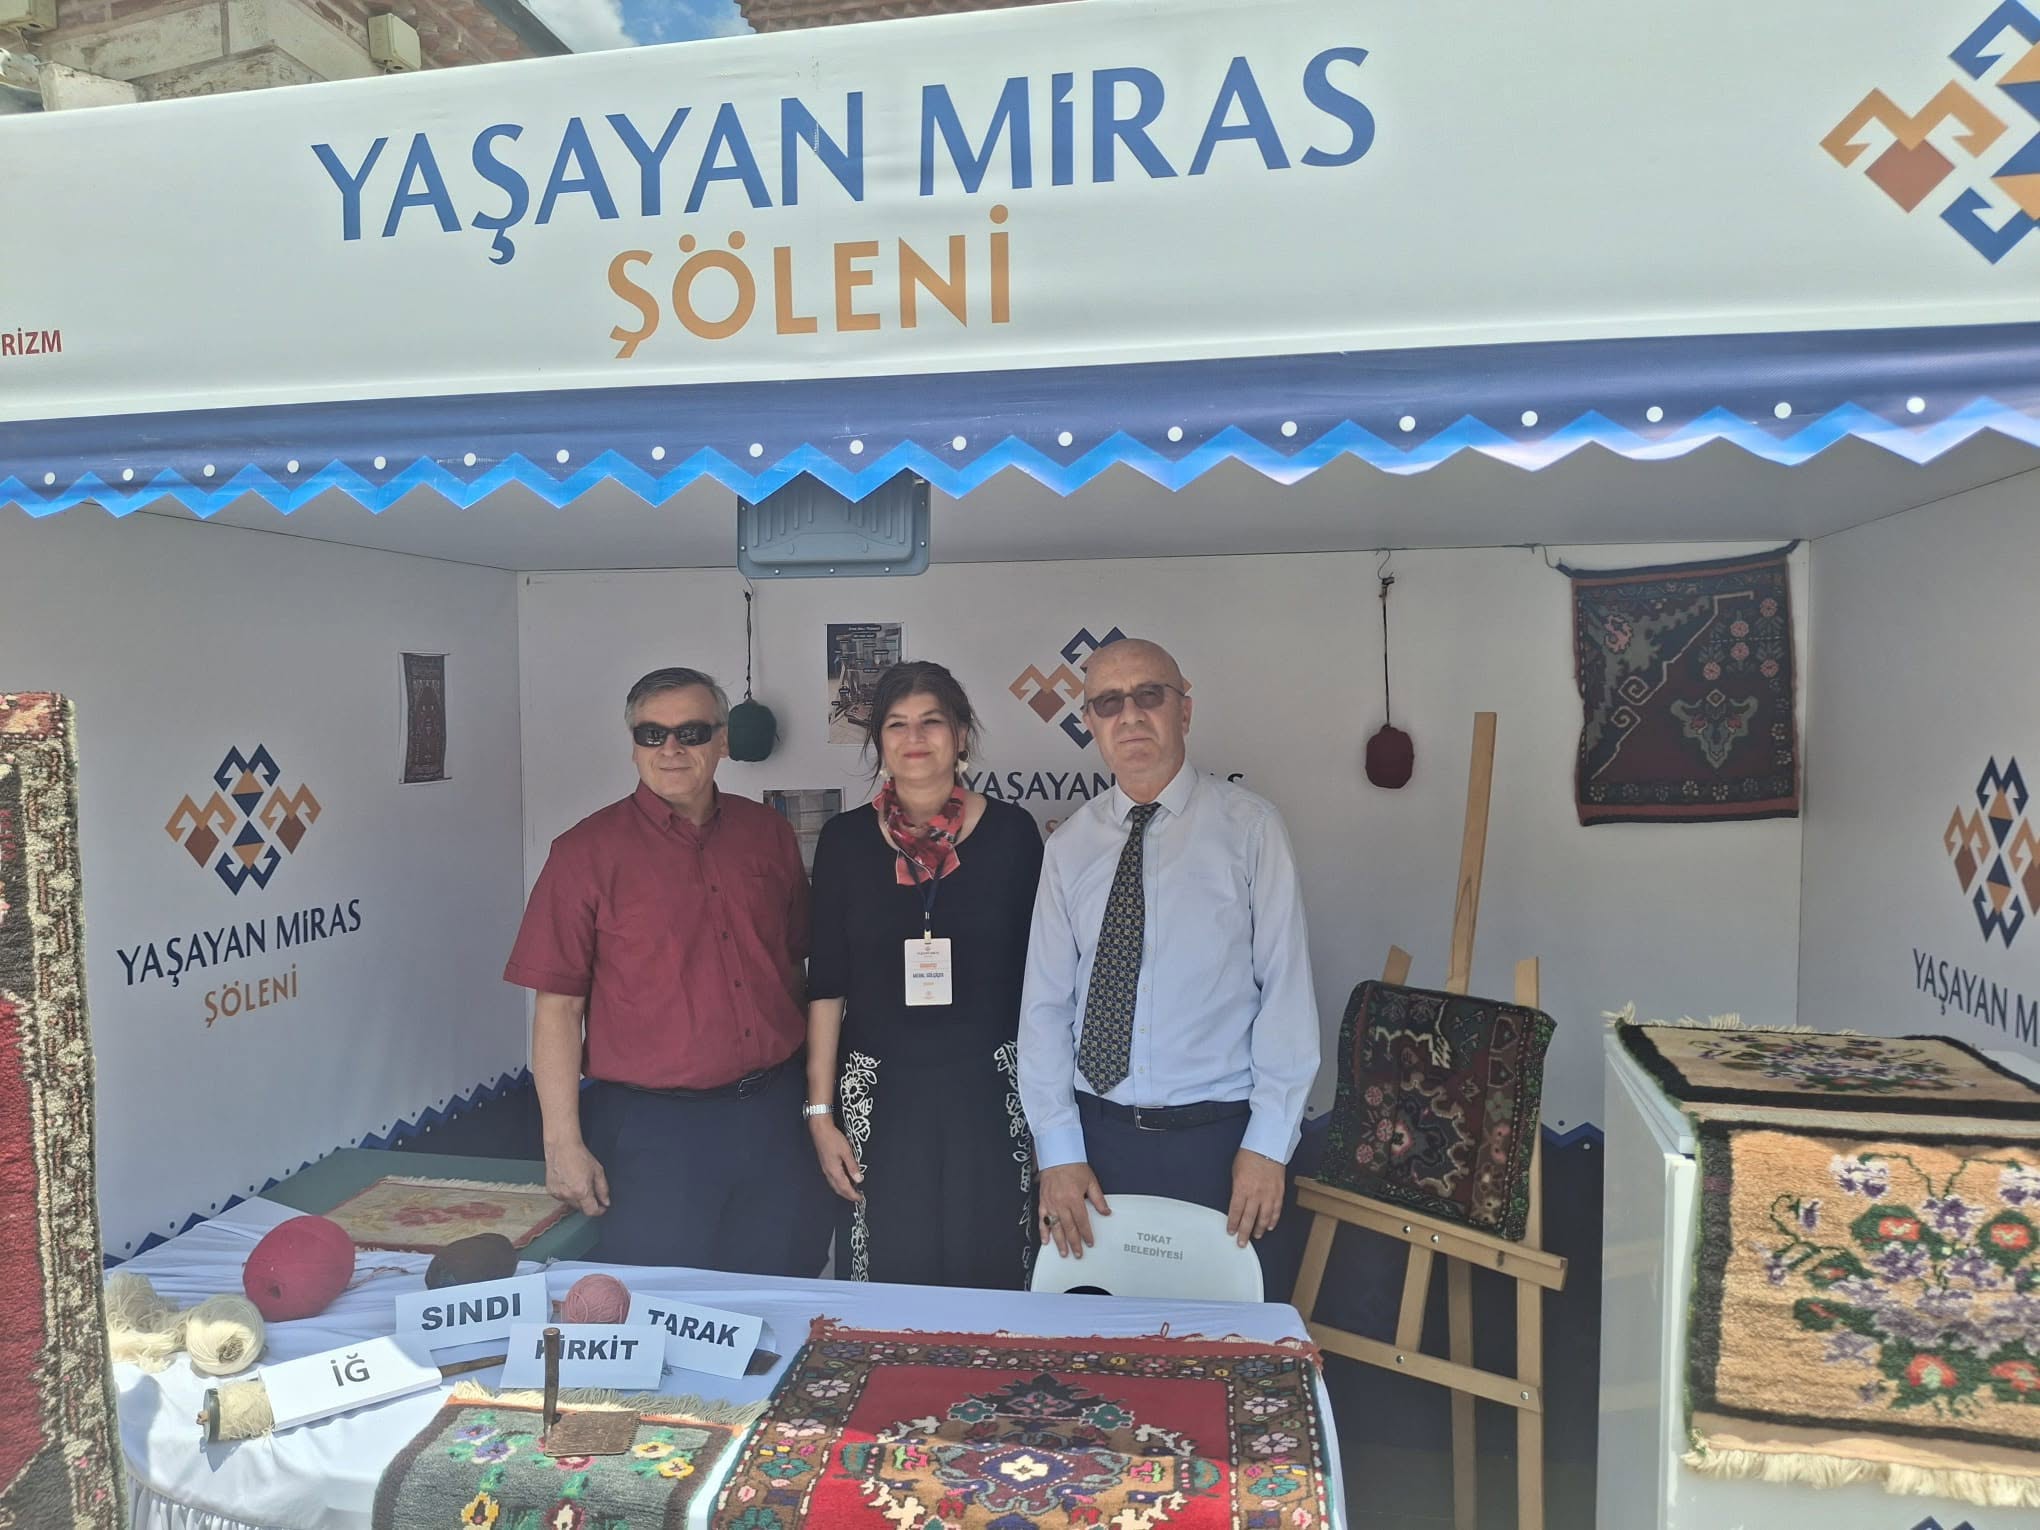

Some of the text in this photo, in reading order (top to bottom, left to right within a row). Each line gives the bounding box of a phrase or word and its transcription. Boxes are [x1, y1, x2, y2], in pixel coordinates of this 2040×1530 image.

[311, 46, 1376, 265] YAŞAYAN MİRAS
[607, 204, 1010, 358] ŞÖLENİ
[960, 771, 1116, 804] YAŞAYAN
[117, 898, 362, 987] YAŞAYAN MİRAS
[203, 963, 298, 1028] ŞÖLENİ
[1912, 947, 2008, 1032] YAŞAYAN
[1123, 1243, 1184, 1261] BELEDİYESİ
[1136, 1231, 1172, 1245] TOKAT
[421, 1293, 521, 1331] SINDI
[647, 1309, 741, 1347] TARAK
[330, 1352, 371, 1387] İĞ
